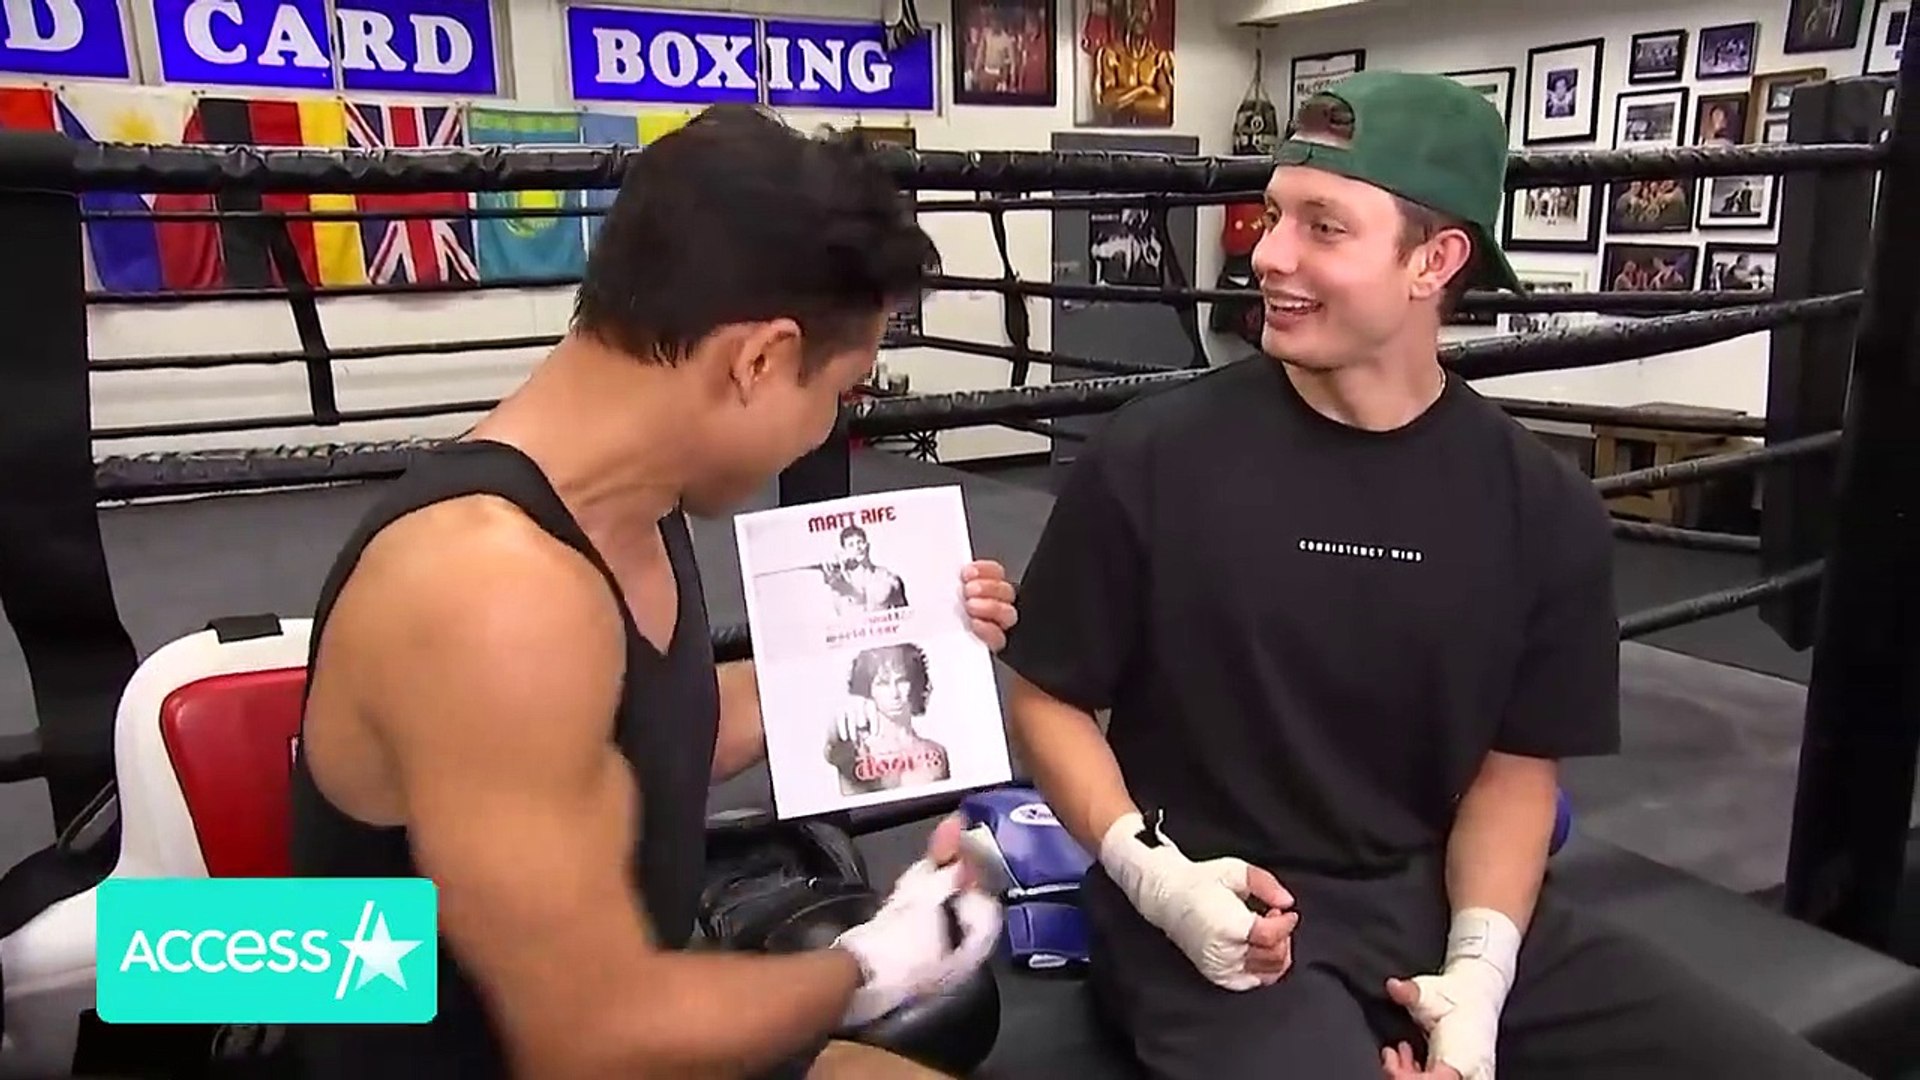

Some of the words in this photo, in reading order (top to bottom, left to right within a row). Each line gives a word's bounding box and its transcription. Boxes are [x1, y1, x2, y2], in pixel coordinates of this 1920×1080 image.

[4, 0, 84, 52] D
[183, 0, 473, 75] CARD
[593, 27, 892, 93] BOXING
[808, 511, 856, 533] MATT
[861, 506, 897, 524] RIFE
[1299, 540, 1384, 557] CONSISTENCY
